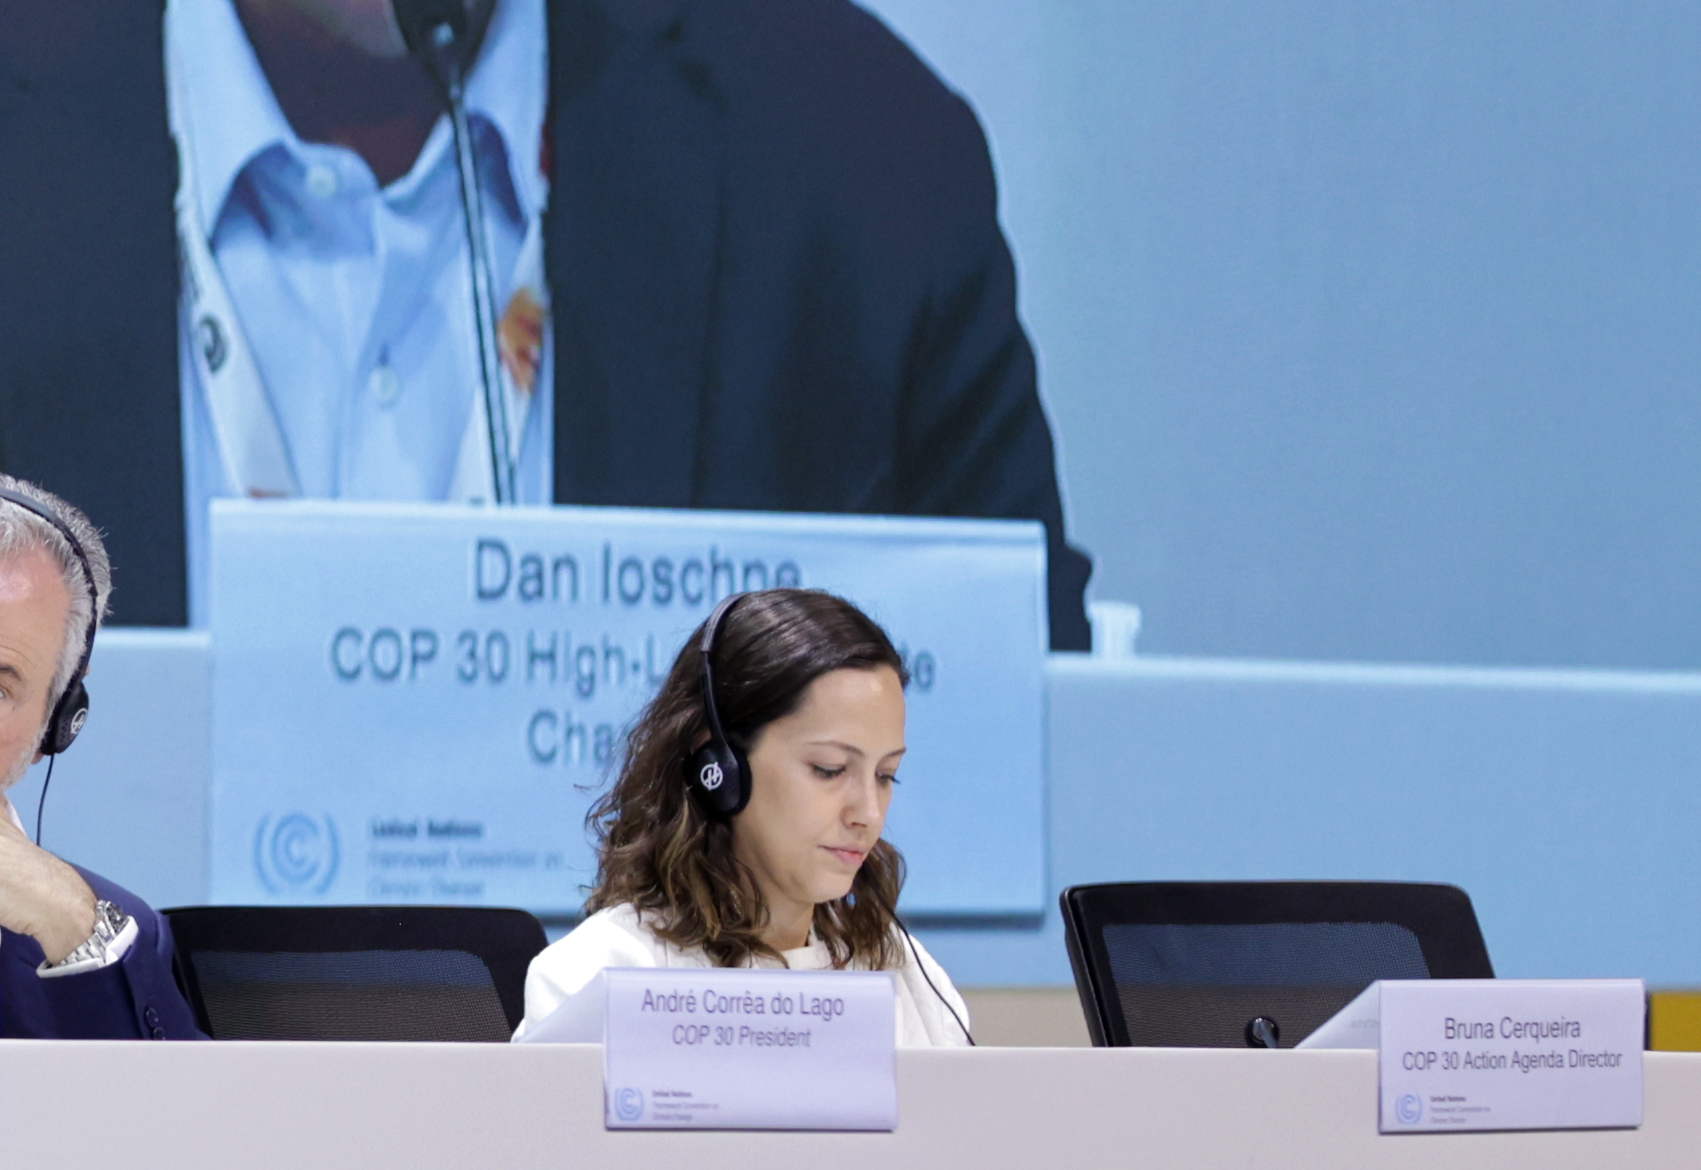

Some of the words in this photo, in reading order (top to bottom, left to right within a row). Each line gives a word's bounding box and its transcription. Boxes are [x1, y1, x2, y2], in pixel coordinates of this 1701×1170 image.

[474, 536, 580, 605] Dan
[330, 626, 440, 685] COP
[455, 628, 512, 686] 30
[641, 988, 698, 1014] André
[702, 989, 766, 1015] Corrêa
[770, 992, 794, 1016] do
[799, 992, 845, 1023] Lago
[672, 1024, 711, 1046] COP
[714, 1025, 734, 1047] 30
[738, 1025, 812, 1048] President
[1444, 1016, 1495, 1040] Bruna
[1499, 1016, 1582, 1044] Cerqueira
[1402, 1050, 1438, 1071] COP
[1441, 1050, 1460, 1071] 30
[1462, 1050, 1507, 1070] Action
[1510, 1050, 1565, 1074] Agenda
[1567, 1048, 1624, 1069] Director
